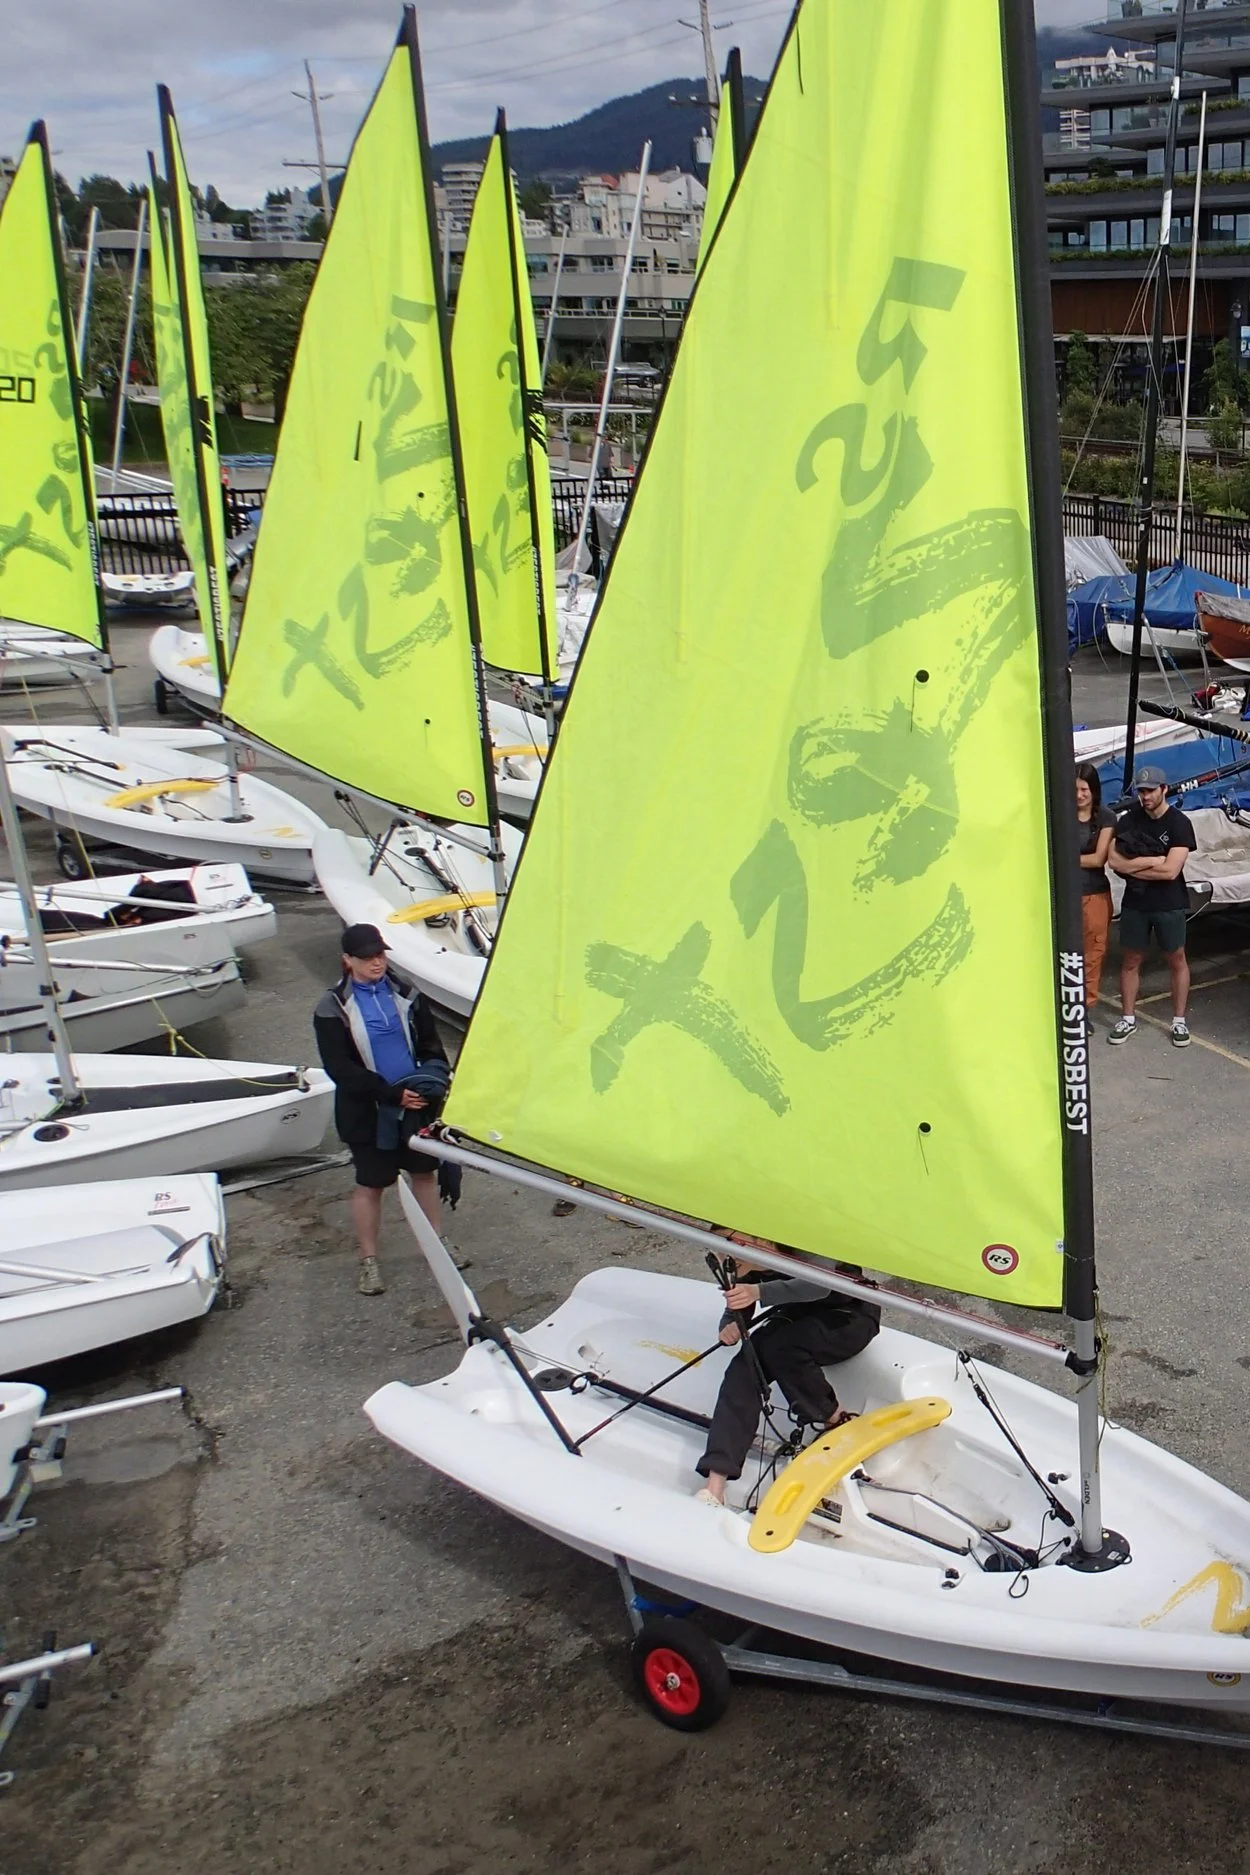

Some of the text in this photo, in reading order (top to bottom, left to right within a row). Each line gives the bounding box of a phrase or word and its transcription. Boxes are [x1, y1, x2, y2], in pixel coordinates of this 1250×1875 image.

[1058, 951, 1089, 1136] #ZESTISBEST
[154, 1191, 172, 1202] RS
[988, 1254, 1012, 1265] RS
